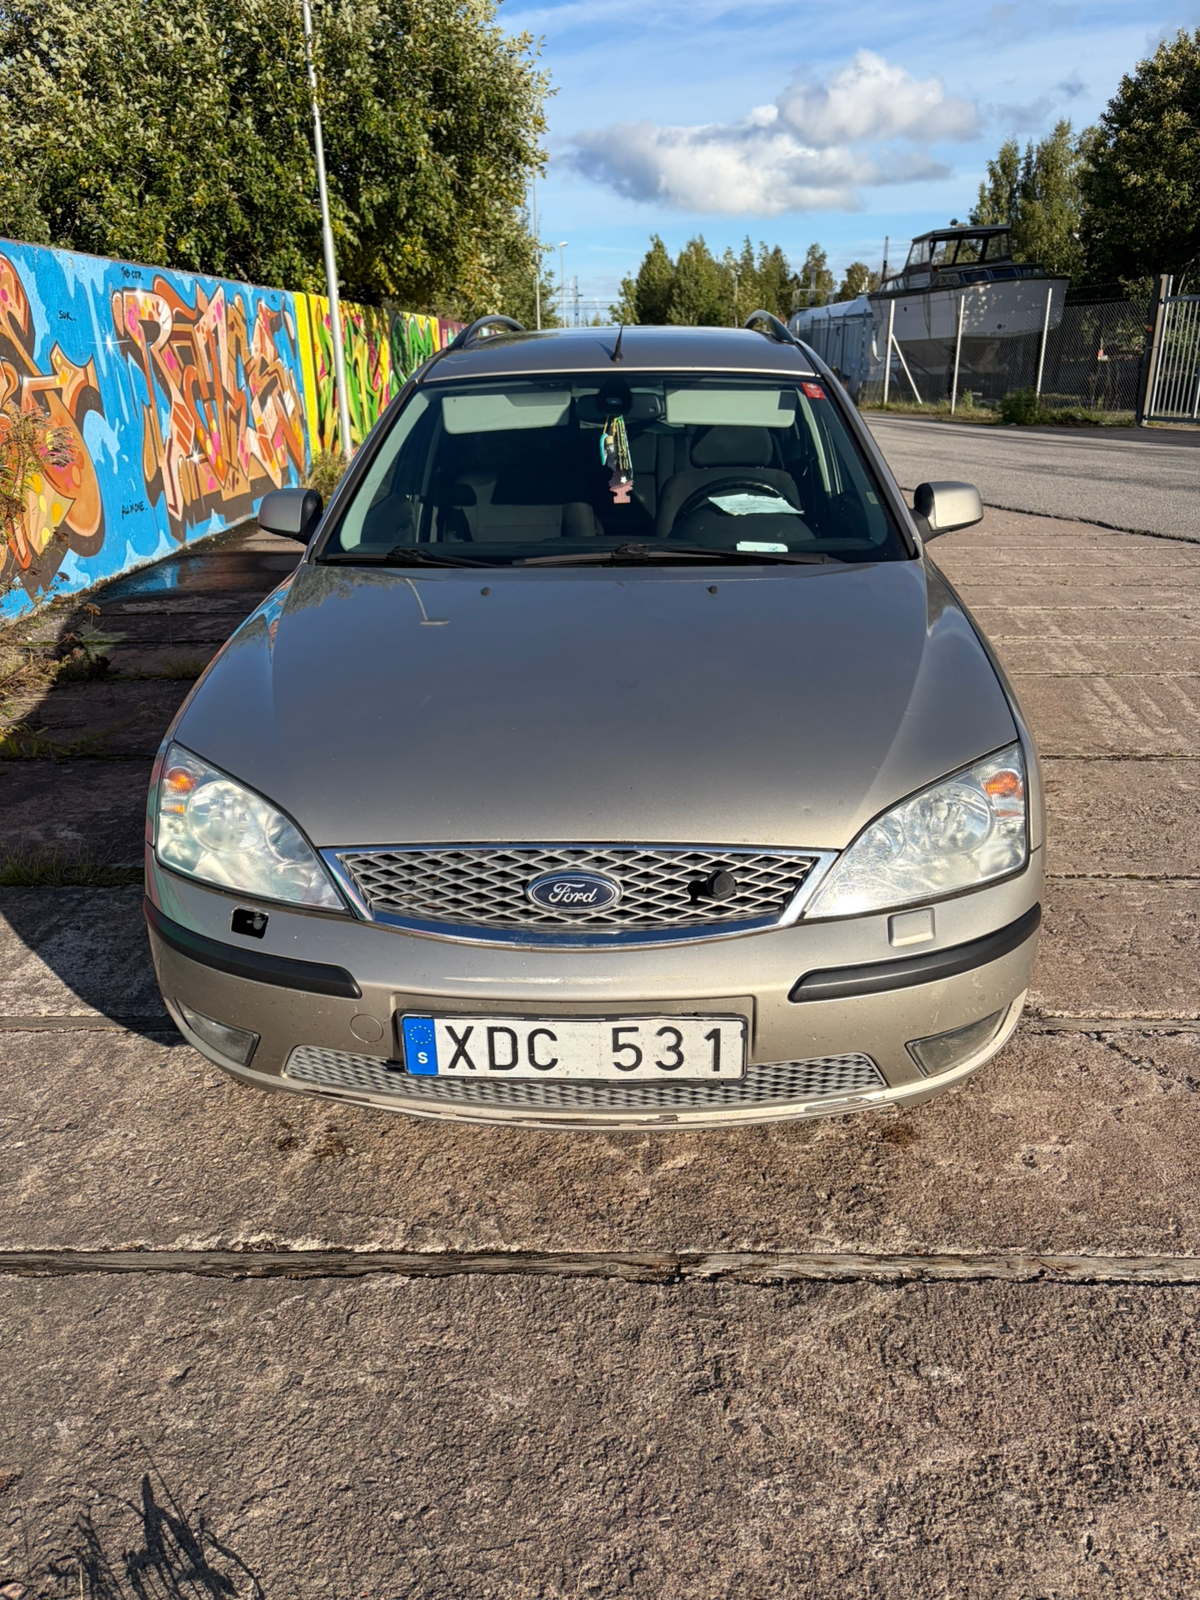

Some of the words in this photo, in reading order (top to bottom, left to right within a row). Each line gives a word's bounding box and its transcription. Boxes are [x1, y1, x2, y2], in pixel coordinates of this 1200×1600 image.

[548, 882, 598, 903] Ford
[417, 1051, 429, 1064] S
[445, 1025, 559, 1071] XDC
[611, 1026, 721, 1072] 531
